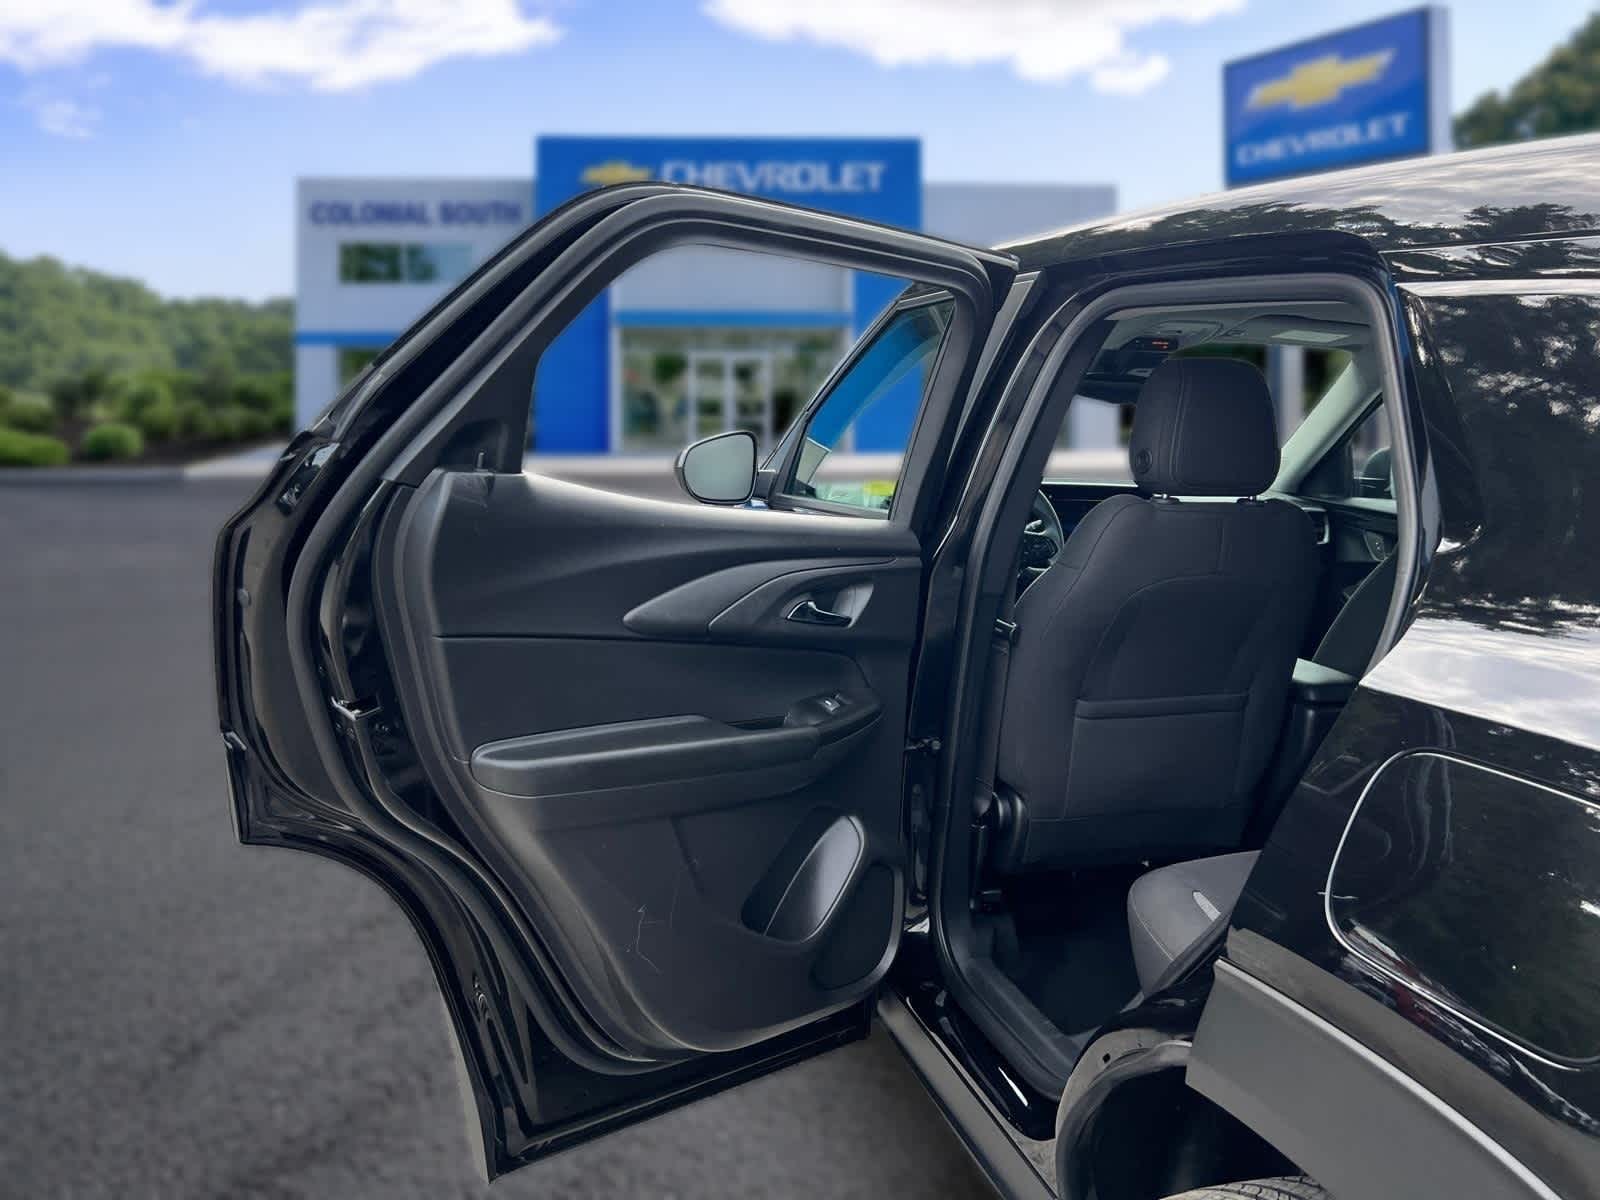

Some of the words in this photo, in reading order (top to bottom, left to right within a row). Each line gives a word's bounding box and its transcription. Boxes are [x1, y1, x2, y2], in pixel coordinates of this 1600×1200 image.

[1235, 112, 1409, 166] CHEVROLET
[662, 160, 885, 192] CHEVROLET
[309, 200, 428, 225] COLONIAL
[439, 200, 522, 224] SOUTH
